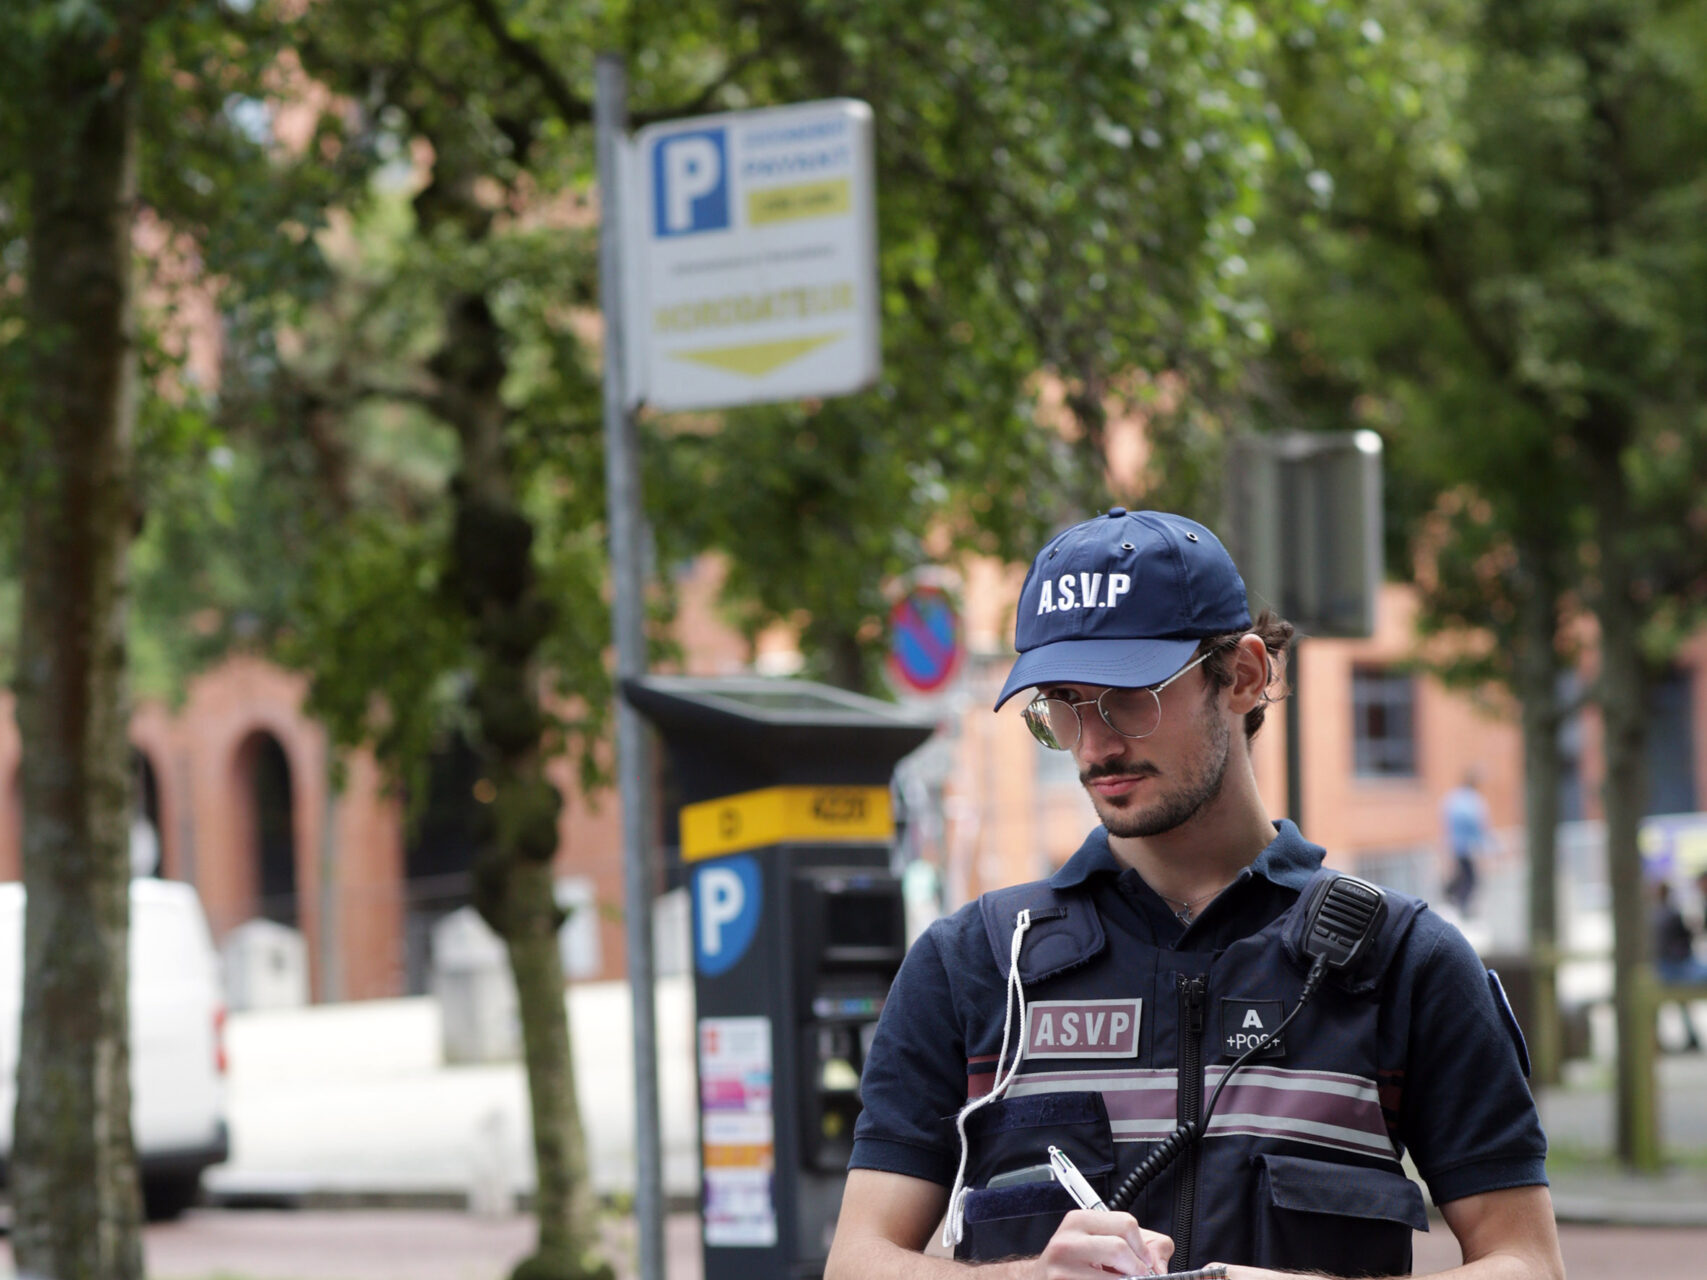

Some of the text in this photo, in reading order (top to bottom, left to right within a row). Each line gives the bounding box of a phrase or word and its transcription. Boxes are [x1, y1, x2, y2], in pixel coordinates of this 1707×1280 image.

[662, 136, 721, 231] P
[1037, 572, 1131, 615] A.S.V.P
[699, 867, 744, 955] P
[1034, 1011, 1130, 1047] A.S.V.P
[1242, 1009, 1264, 1028] A
